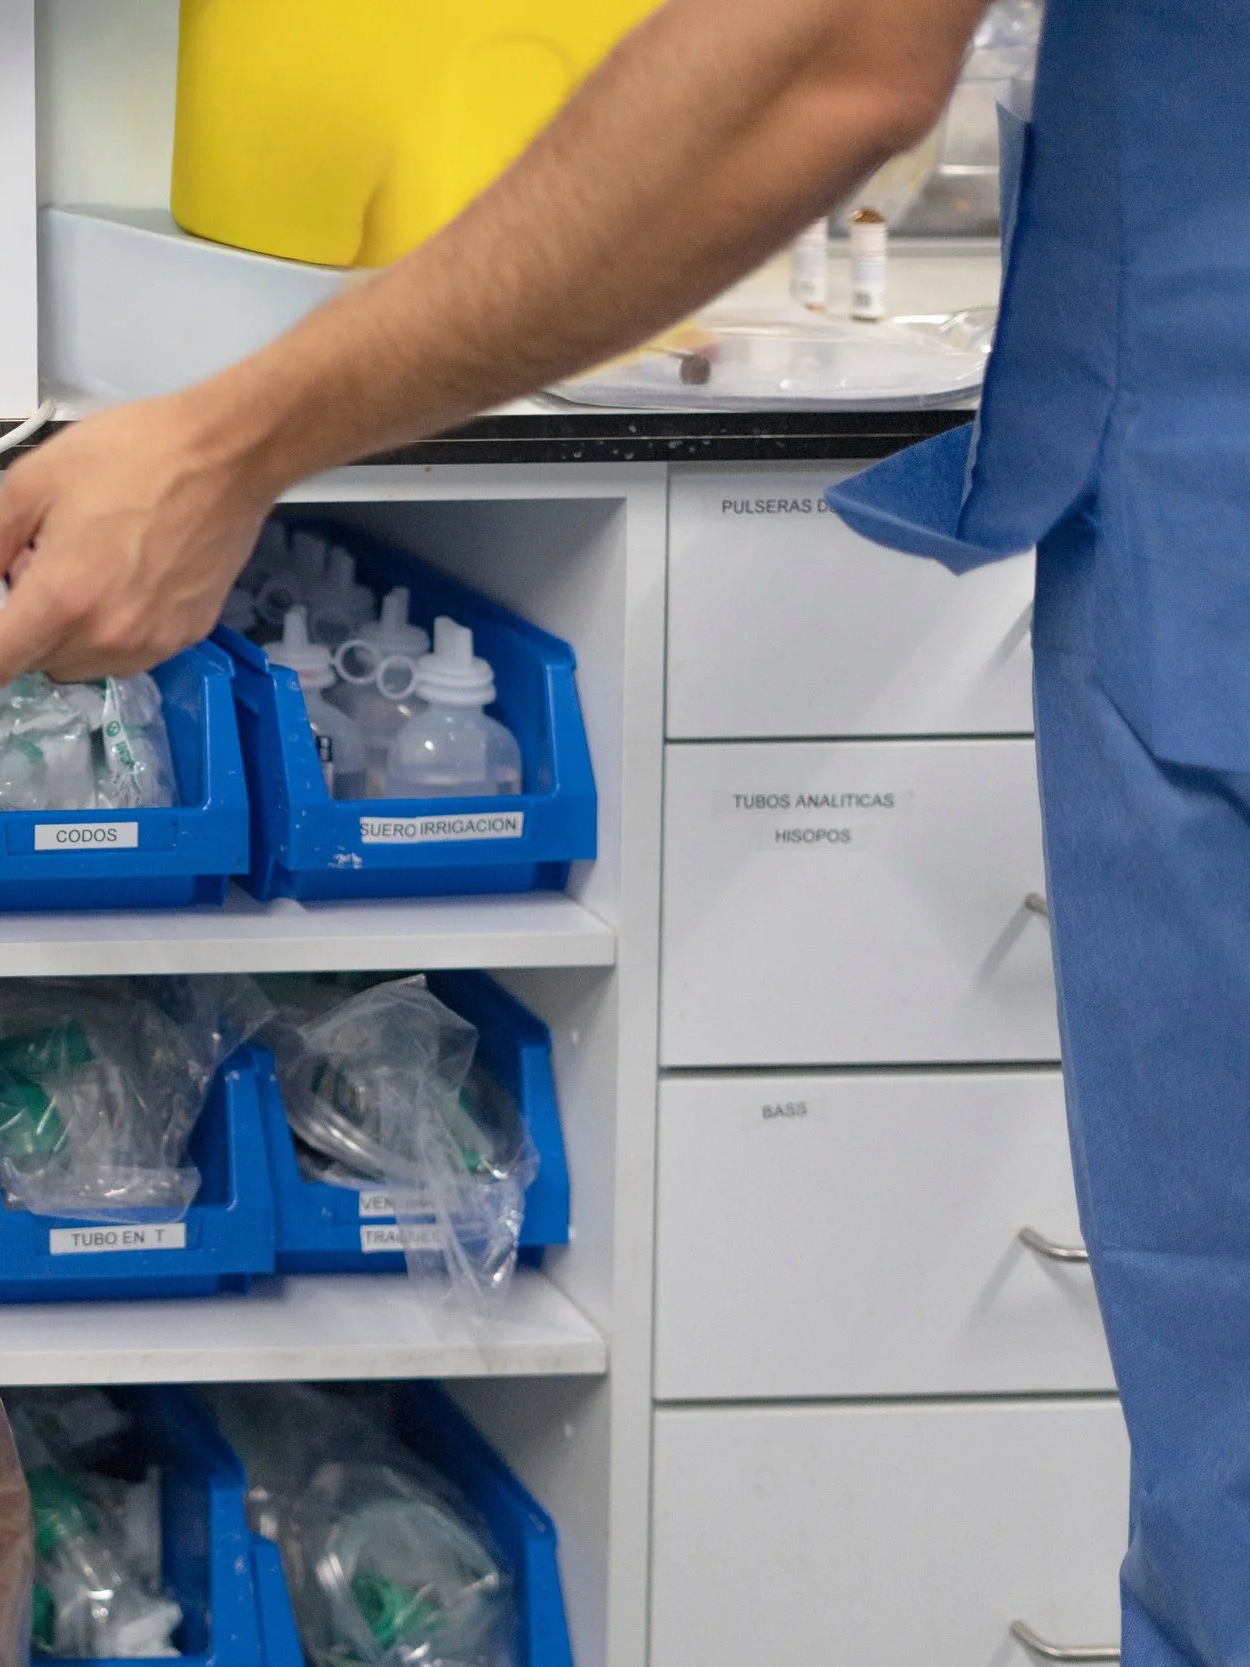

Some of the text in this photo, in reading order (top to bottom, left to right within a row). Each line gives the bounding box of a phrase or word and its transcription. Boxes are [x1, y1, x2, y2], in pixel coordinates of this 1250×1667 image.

[722, 499, 813, 514] PULSERAS
[733, 792, 895, 809] TUBOS ANALITICAS
[56, 828, 117, 843] CODOS
[361, 818, 517, 838] SUERO IRRIGACION
[774, 828, 851, 844] HISOPOS
[71, 1228, 165, 1247] TUBO EN T
